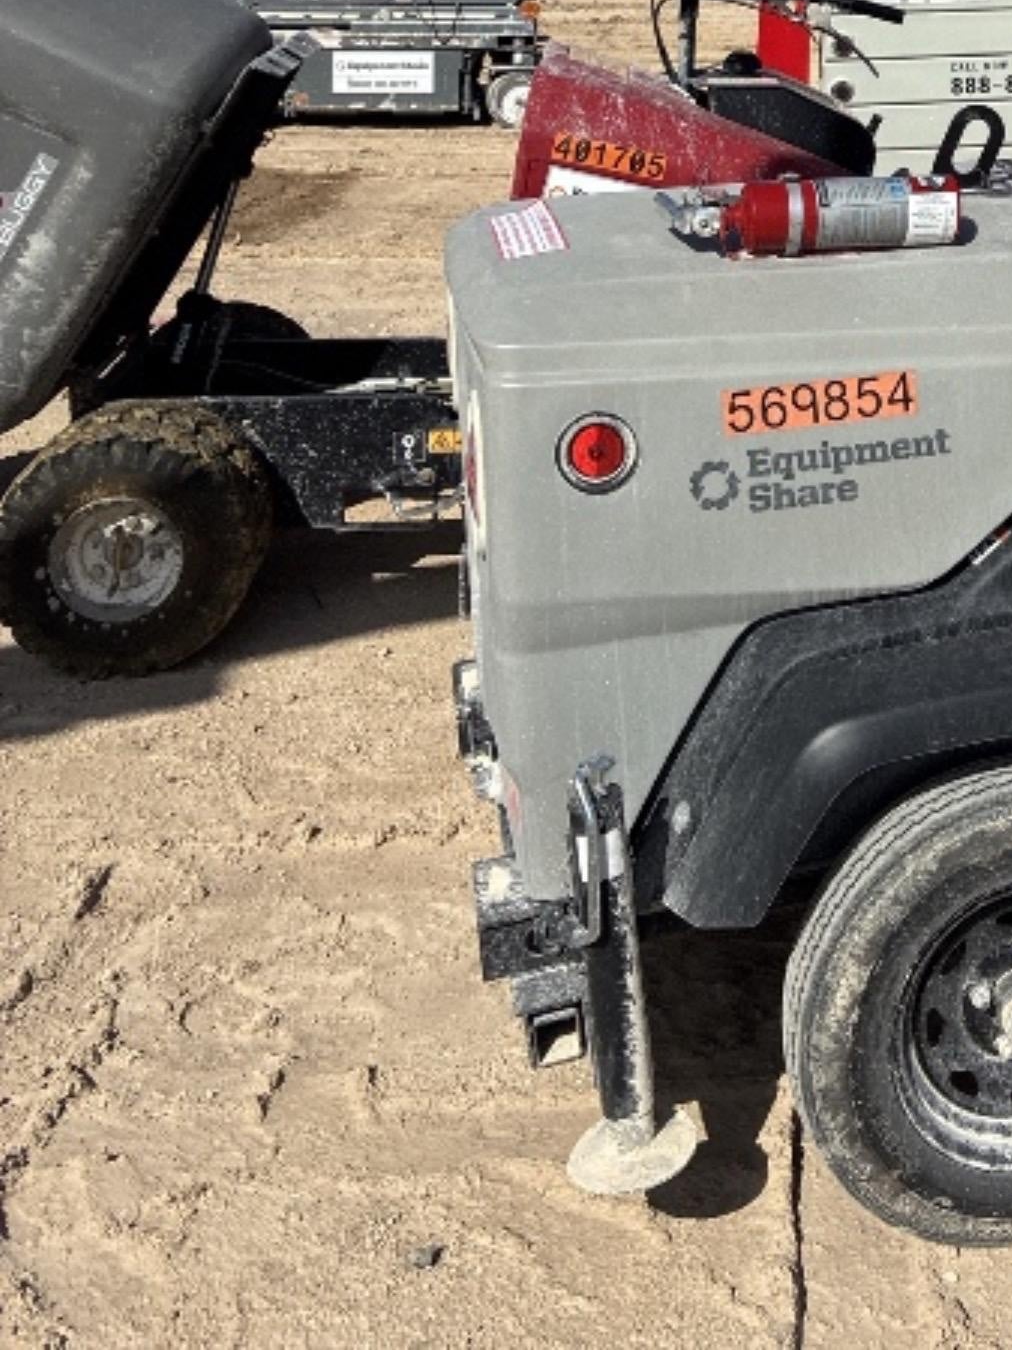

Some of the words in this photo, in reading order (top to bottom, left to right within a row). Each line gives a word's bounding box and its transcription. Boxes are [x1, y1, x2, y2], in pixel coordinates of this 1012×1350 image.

[554, 134, 665, 178] 401705
[727, 370, 915, 434] 569854
[746, 427, 953, 481] Equipment
[748, 478, 860, 514] Share
